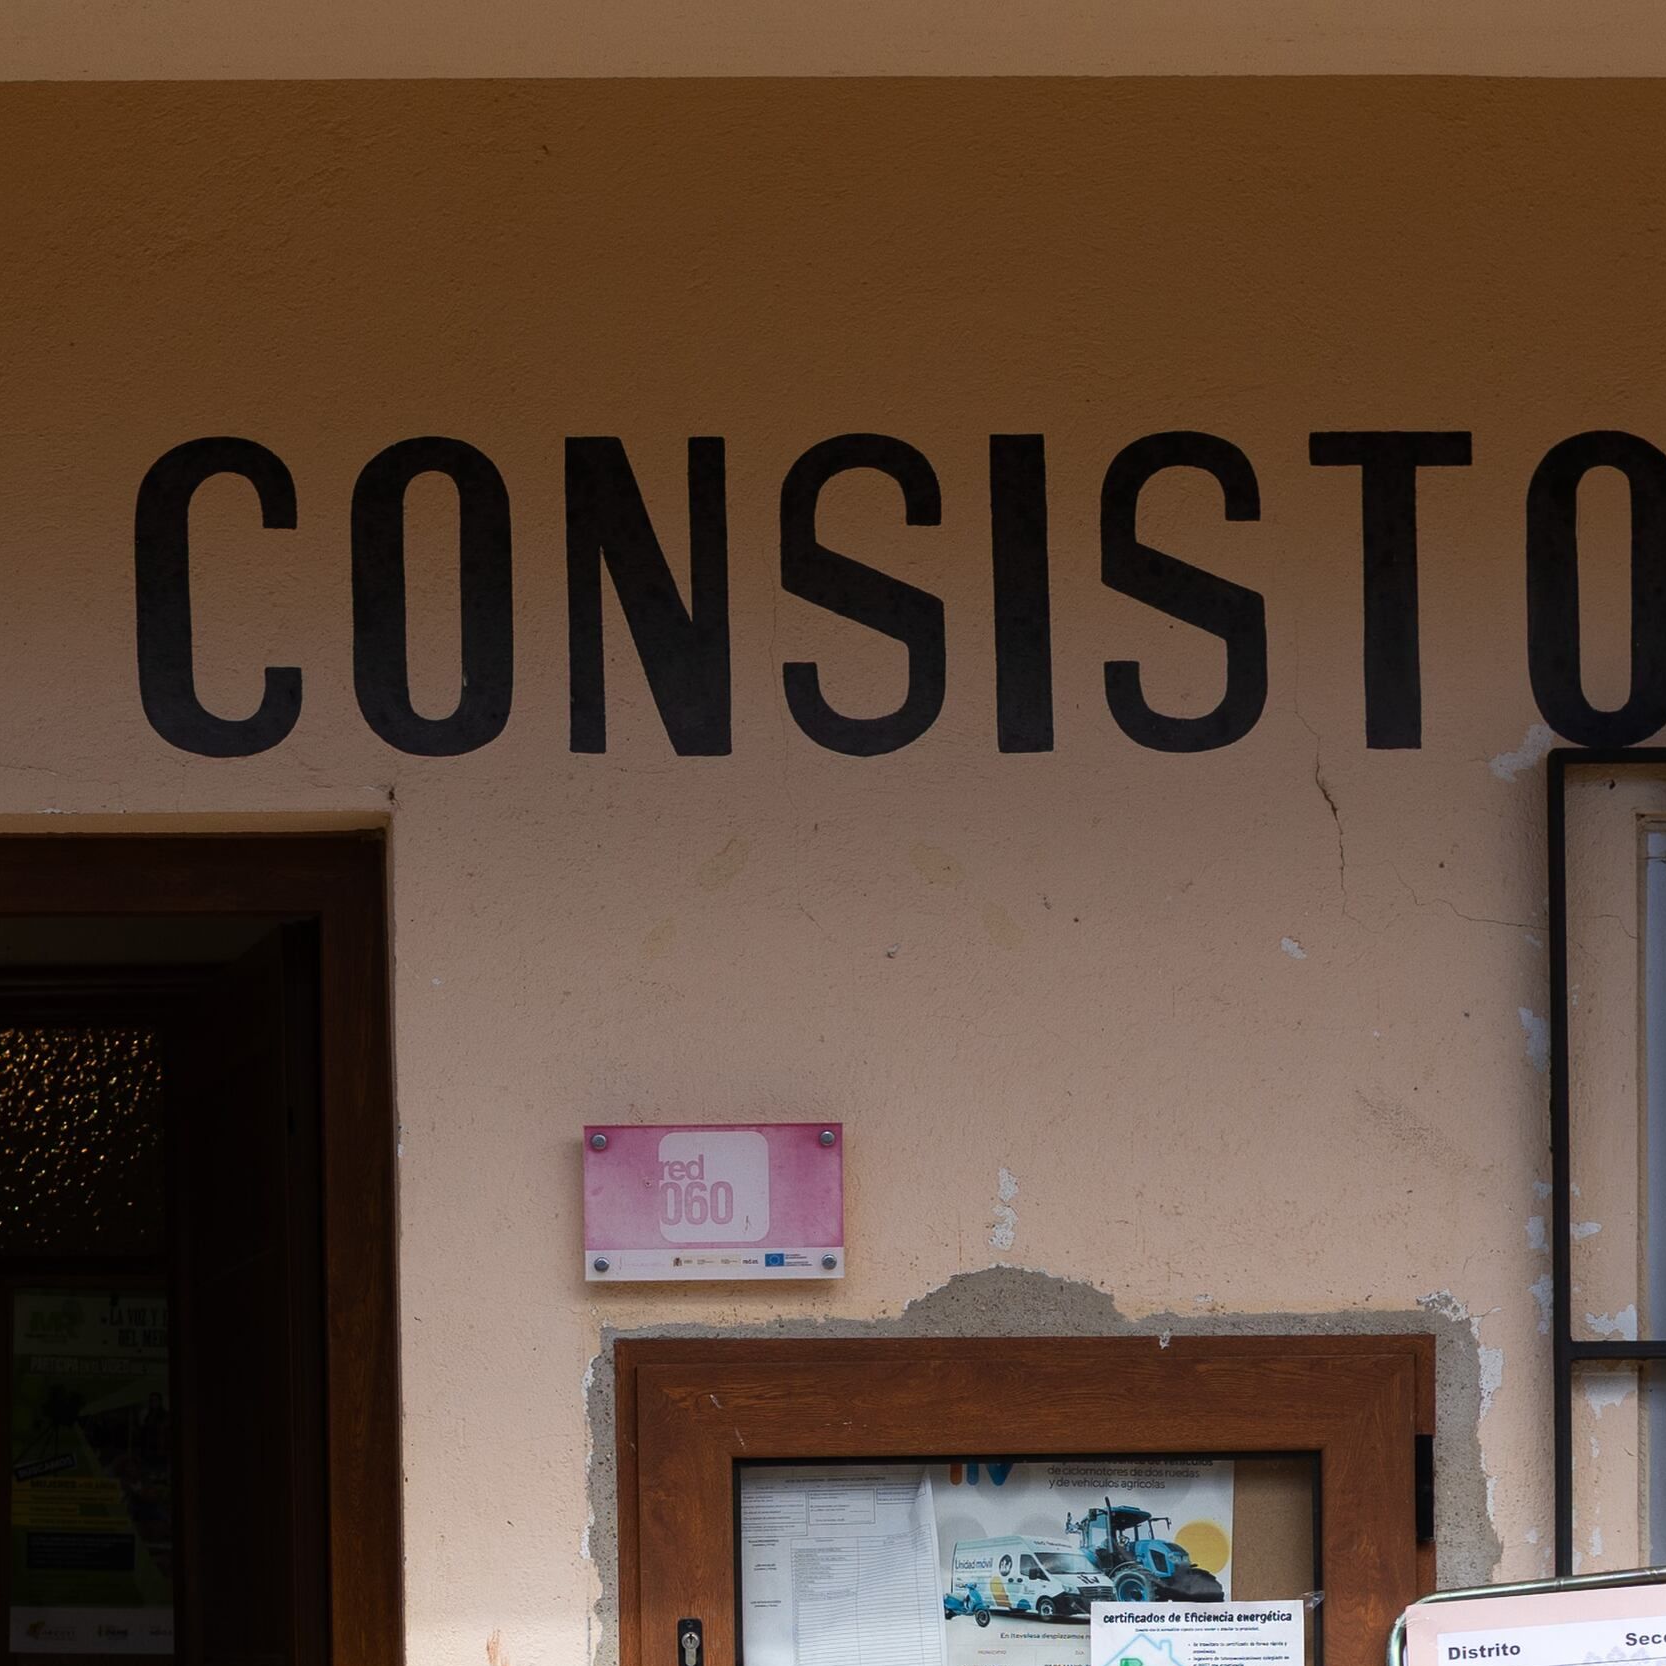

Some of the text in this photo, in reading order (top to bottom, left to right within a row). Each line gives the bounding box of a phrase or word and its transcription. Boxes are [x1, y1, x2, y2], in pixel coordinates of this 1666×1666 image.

[658, 1154, 704, 1181] red
[661, 1182, 734, 1226] 060
[1103, 1610, 1292, 1624] certificados de Eficiencia energética
[1448, 1642, 1521, 1661] Distrito
